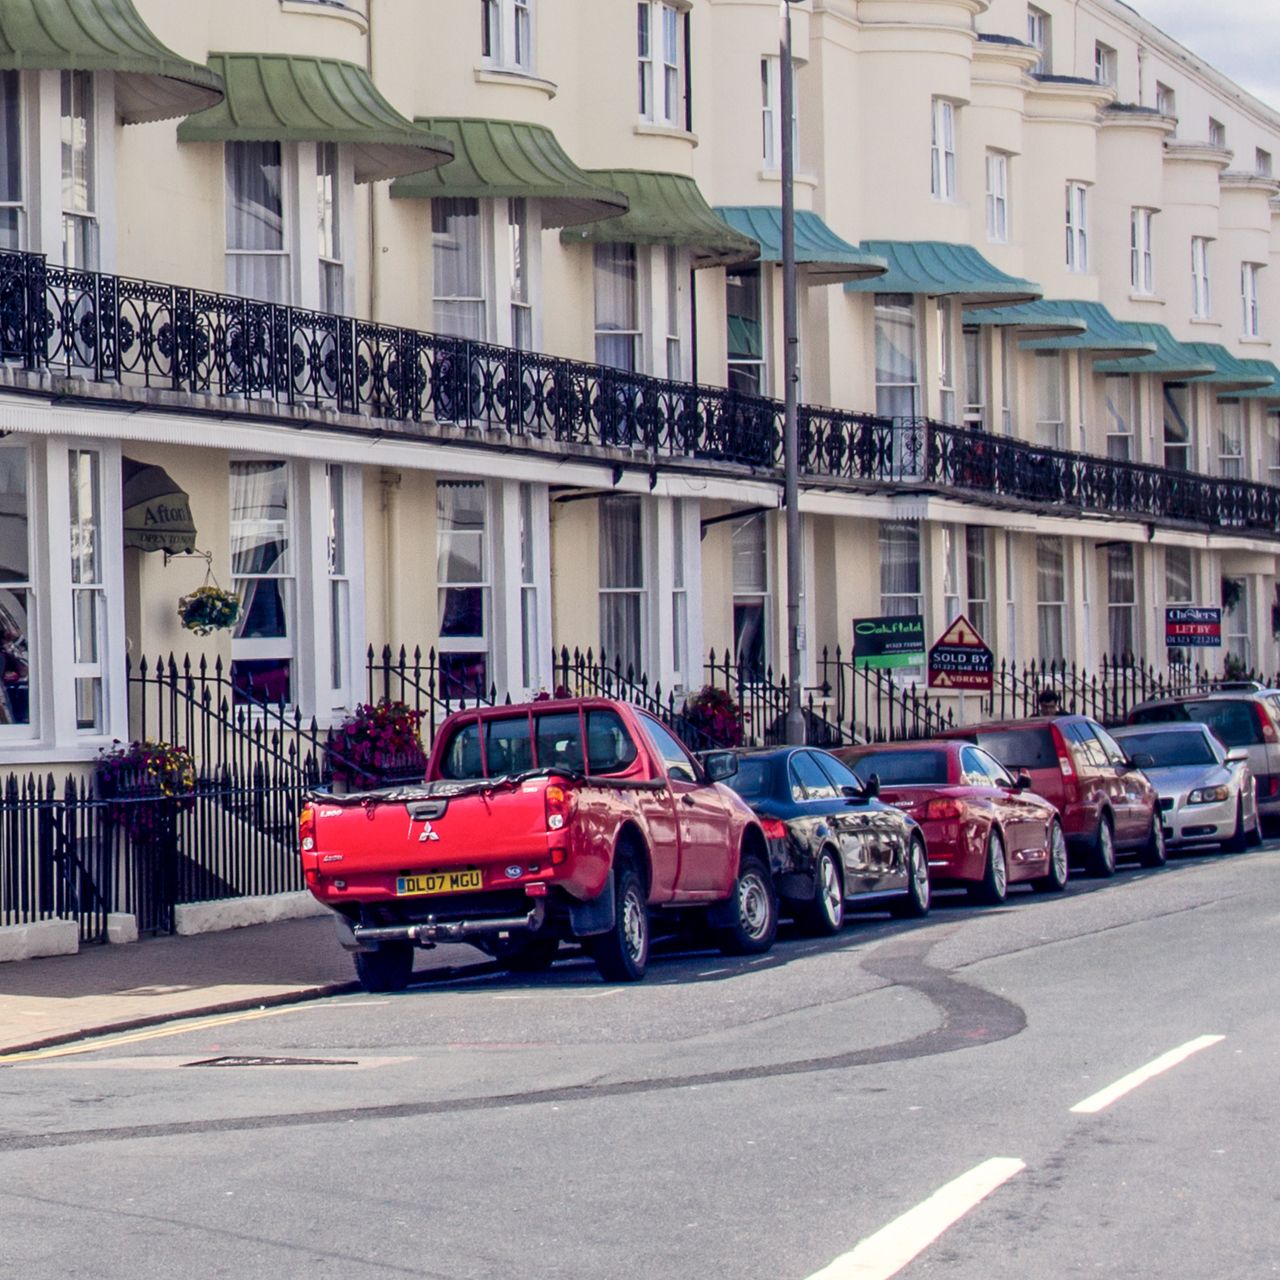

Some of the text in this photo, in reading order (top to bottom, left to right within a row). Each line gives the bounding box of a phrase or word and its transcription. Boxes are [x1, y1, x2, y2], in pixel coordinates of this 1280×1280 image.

[856, 622, 922, 635] Oakfield
[1176, 624, 1210, 634] LET BY
[933, 653, 967, 662] SOLD
[972, 654, 988, 663] BY
[406, 872, 480, 892] DL07 MGU
